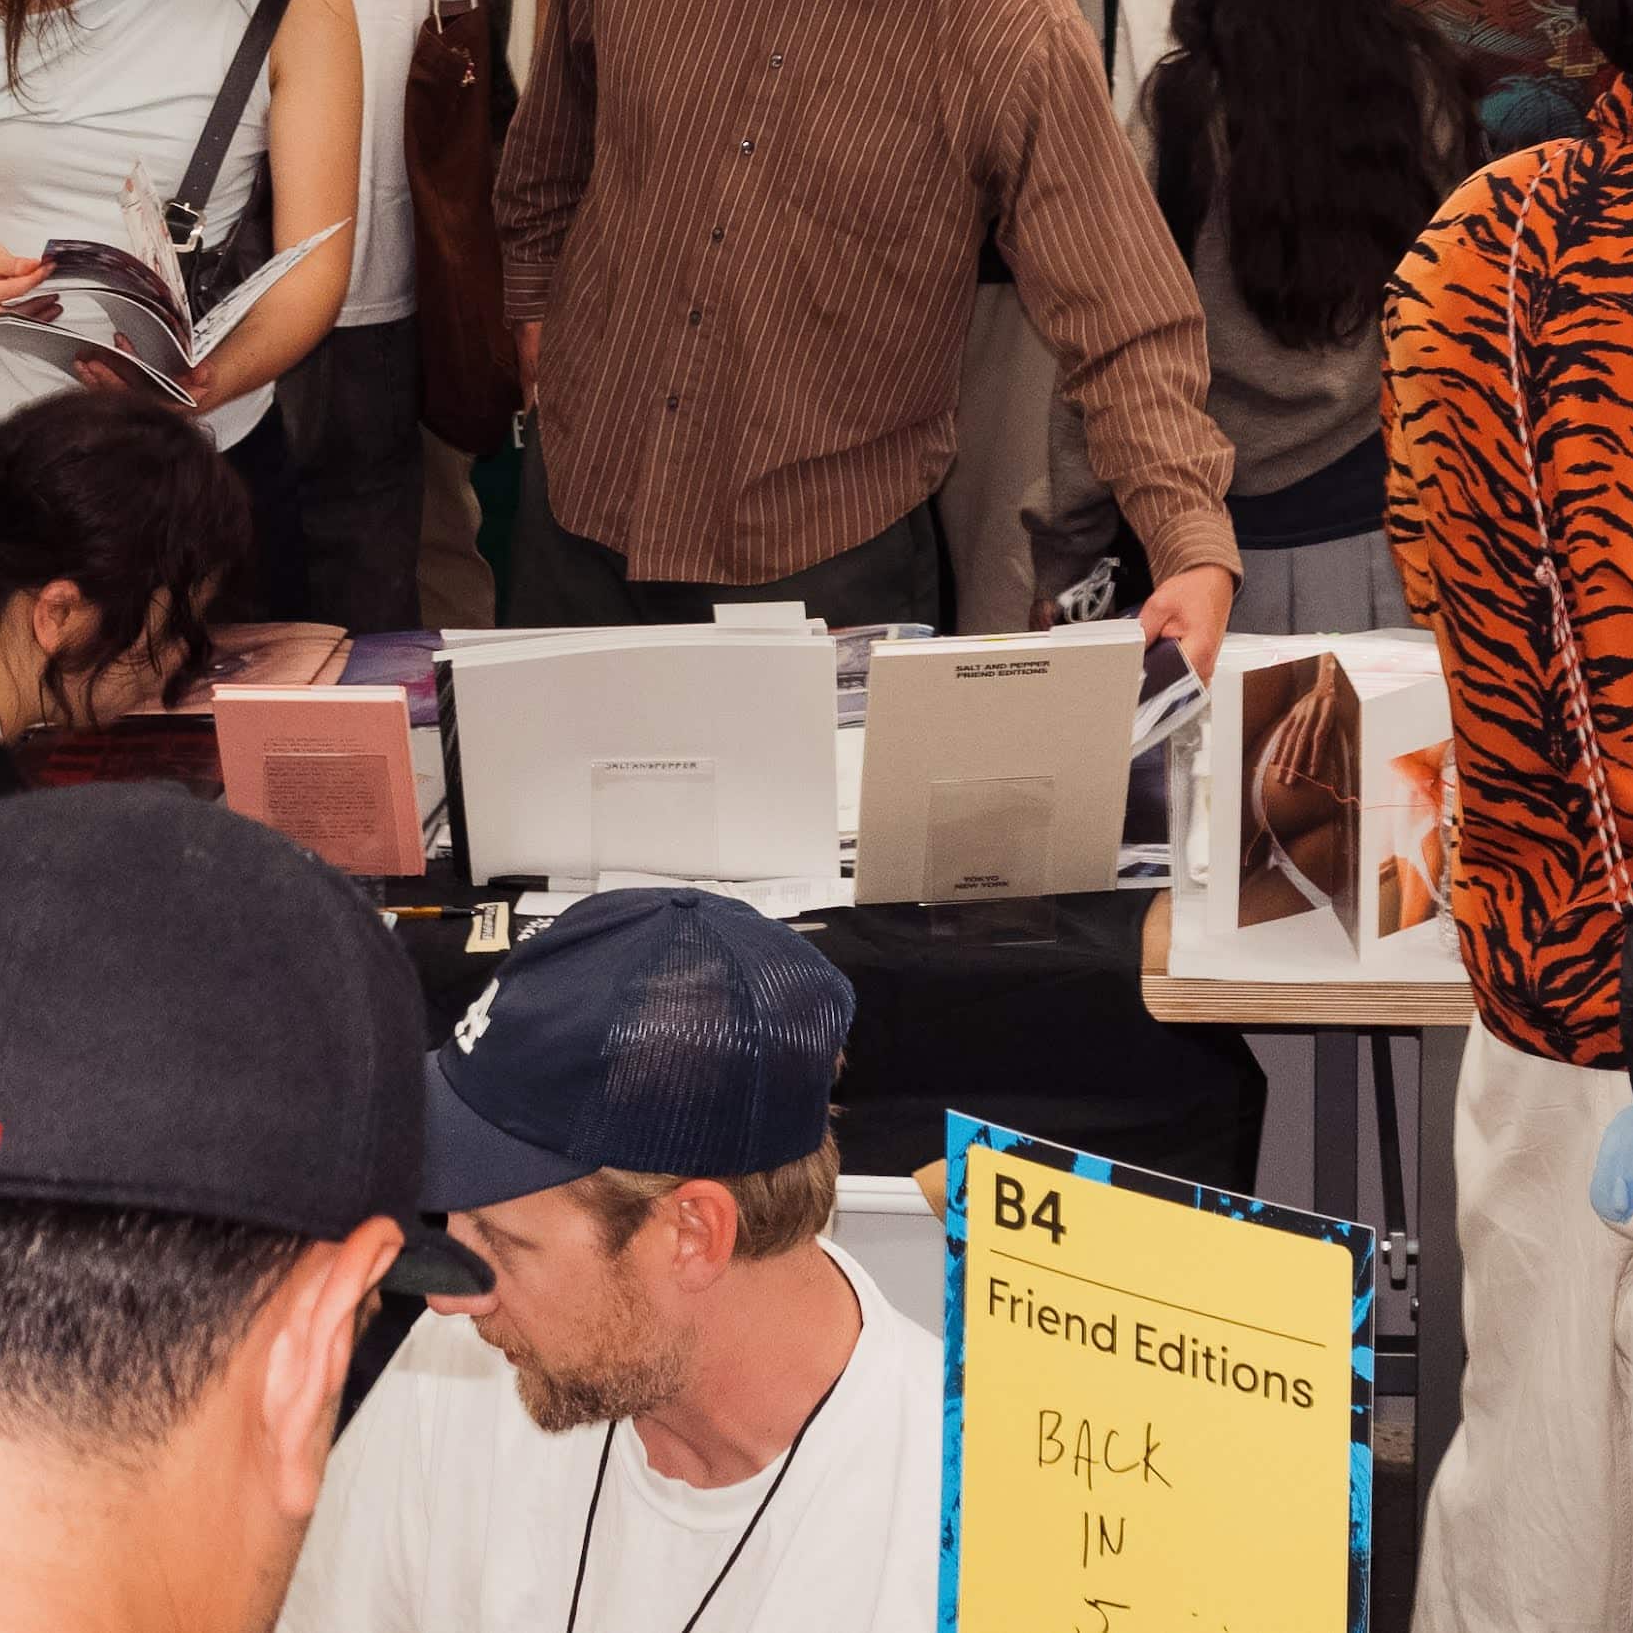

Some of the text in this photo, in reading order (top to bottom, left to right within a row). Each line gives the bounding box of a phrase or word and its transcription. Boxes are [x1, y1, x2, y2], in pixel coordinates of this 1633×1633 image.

[998, 668, 1047, 677] EDITIONS
[1010, 660, 1050, 669] PEPPER
[994, 1174, 1067, 1246] B4
[988, 1277, 1315, 1409] Friend Editions
[1038, 1409, 1173, 1490] BACK
[1082, 1511, 1126, 1568] IN
